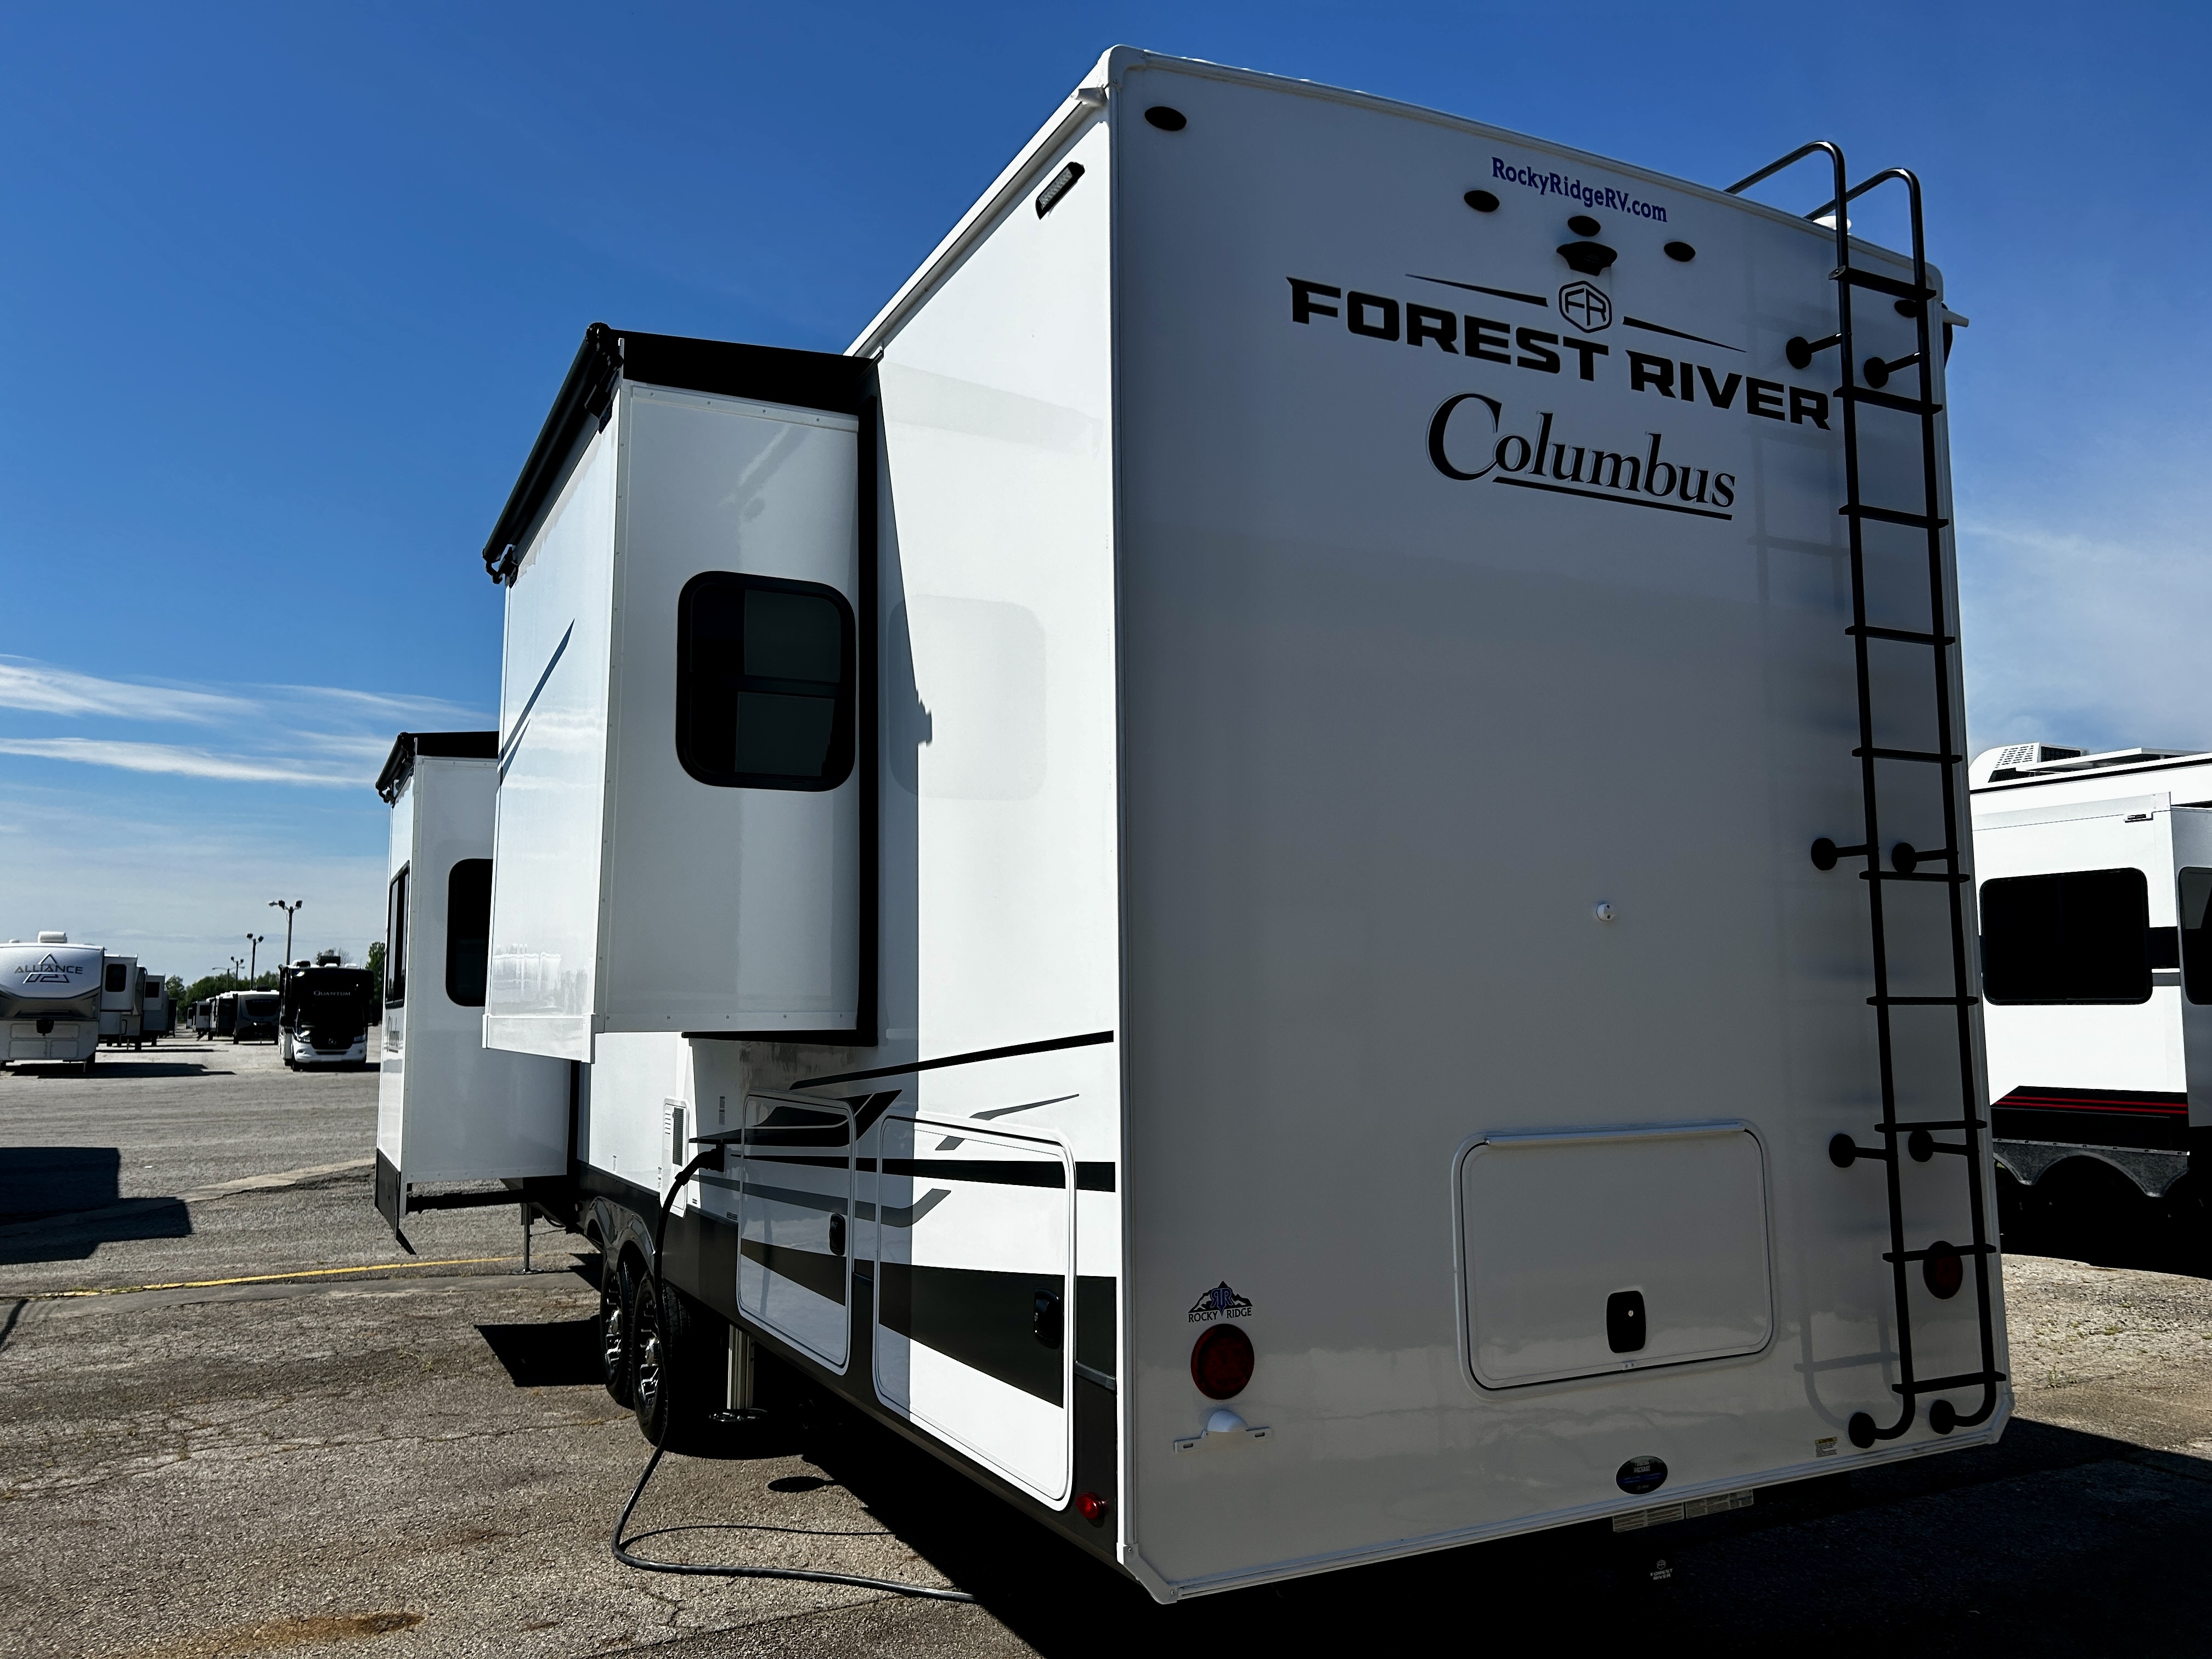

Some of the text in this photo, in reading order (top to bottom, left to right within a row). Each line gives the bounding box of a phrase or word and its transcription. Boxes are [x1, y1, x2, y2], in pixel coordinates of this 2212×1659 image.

[1491, 156, 1668, 223] RockyRidgeRV.com
[1285, 276, 1831, 431] FOREST RIVER
[1426, 392, 1736, 509] Columbus
[14, 964, 83, 974] ALLIANCE
[1188, 1307, 1252, 1323] ROCKY RIDGE
[1650, 1568, 1673, 1577] FOREST
